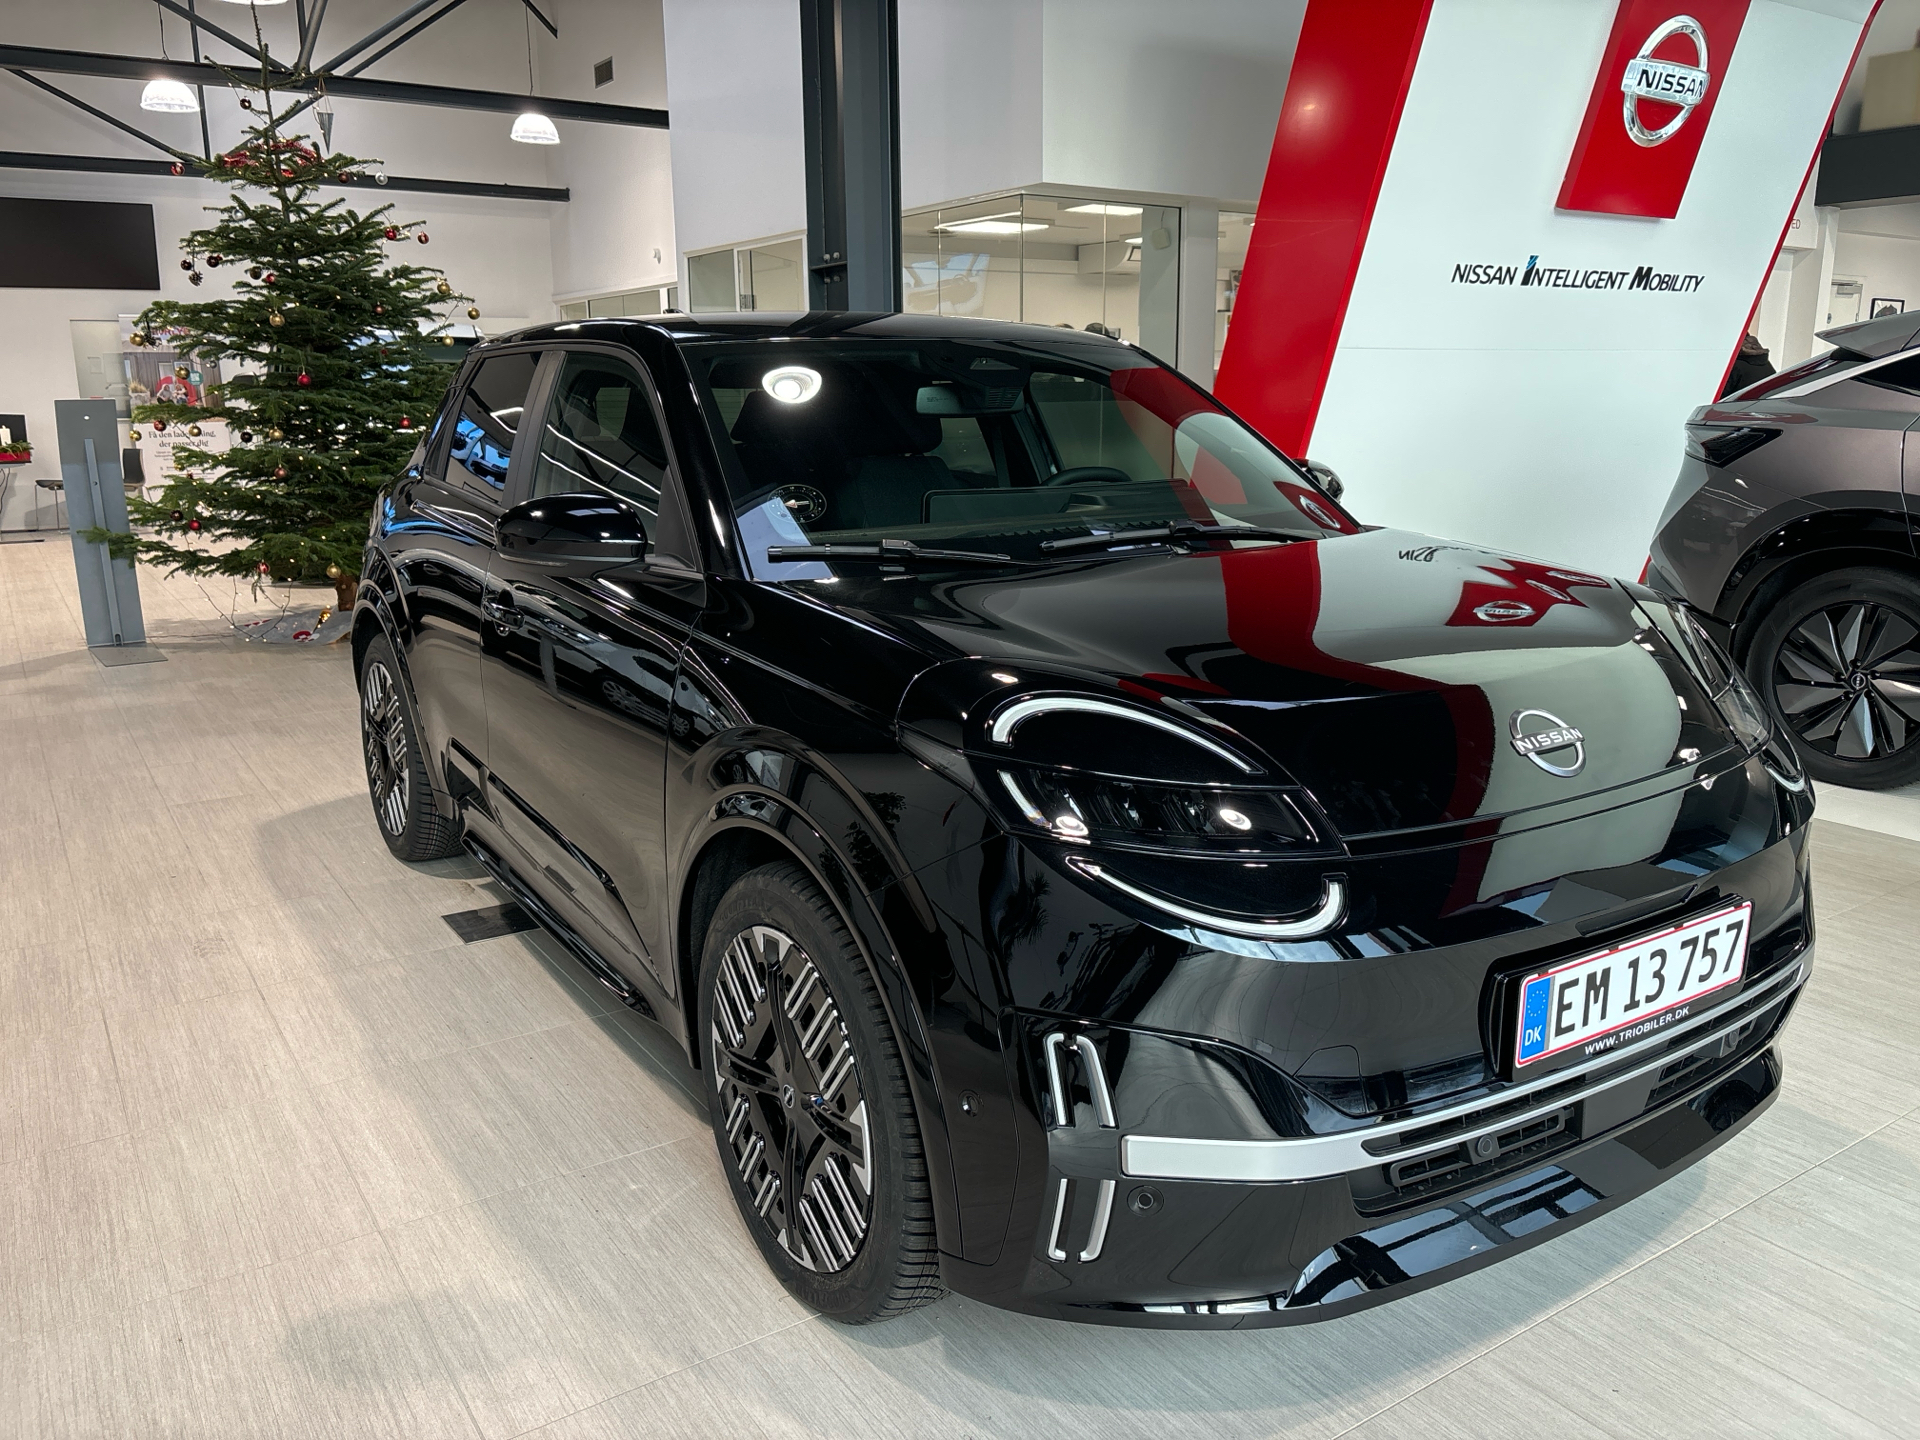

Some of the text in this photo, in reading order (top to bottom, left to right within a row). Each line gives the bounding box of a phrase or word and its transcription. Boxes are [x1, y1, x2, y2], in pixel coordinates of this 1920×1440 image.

[1637, 67, 1707, 98] NISSAN
[1451, 254, 1706, 294] NISSAN INTELLIGENT MOBILITY
[158, 439, 171, 448] der
[159, 431, 173, 439] den
[1516, 728, 1583, 753] NISSAN
[1554, 919, 1744, 1038] EM 13 757
[1524, 1025, 1542, 1047] DK
[1584, 1005, 1690, 1055] WWW.TRIOBILER.DK
